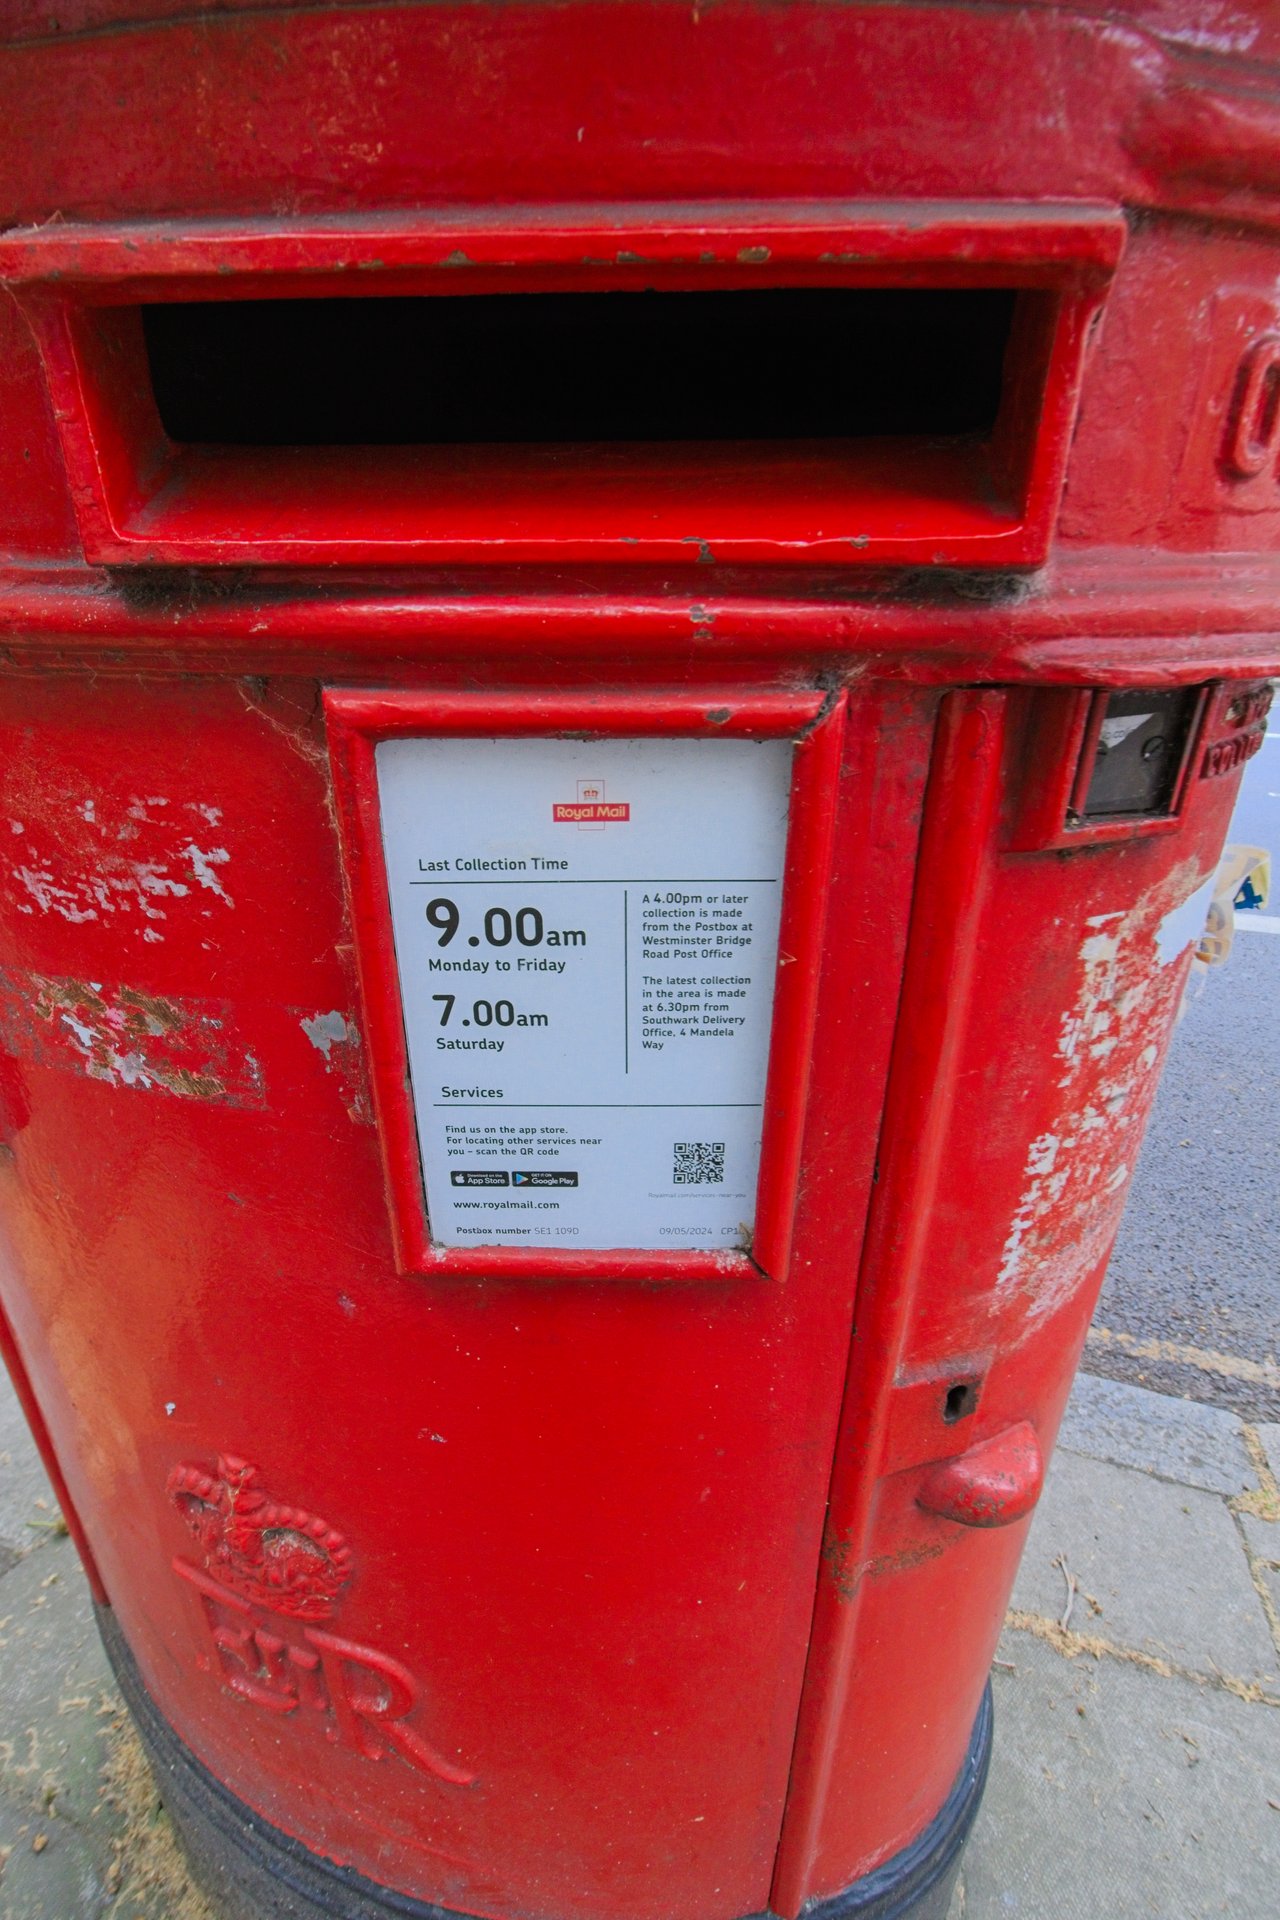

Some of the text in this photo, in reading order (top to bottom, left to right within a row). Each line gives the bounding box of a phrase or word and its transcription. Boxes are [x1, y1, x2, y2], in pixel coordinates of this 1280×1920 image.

[556, 805, 626, 821] Royal Mail
[418, 857, 569, 872] Last Collection Time
[641, 892, 750, 906] A 4.00pm or later
[642, 907, 743, 918] collection is made
[425, 897, 587, 948] 9.00am
[642, 921, 754, 932] from the Postbox at
[641, 935, 753, 947] Westminster Bridge
[642, 948, 734, 959] Road Post Office
[428, 957, 566, 974] Monday to Friday
[642, 975, 752, 986] The latest collection
[642, 988, 747, 999] in the area is made
[431, 994, 549, 1027] 7.00am
[641, 1001, 730, 1014] at 6.30pm from
[642, 1015, 746, 1026] Southwark Delivery
[679, 1027, 687, 1037] 4
[689, 1027, 735, 1037] Mandela
[436, 1037, 505, 1053] Saturday
[641, 1040, 665, 1051] Way
[441, 1085, 504, 1099] Services
[445, 1125, 467, 1134] Find
[499, 1125, 516, 1134] the
[518, 1127, 538, 1136] app
[539, 1126, 569, 1134] store.
[446, 1136, 463, 1145] For
[465, 1136, 504, 1147] locating
[507, 1136, 534, 1145] other
[536, 1136, 577, 1145] services
[447, 1148, 465, 1157] you
[475, 1148, 498, 1156] scan
[499, 1146, 517, 1156] the
[519, 1147, 534, 1157] QR
[536, 1147, 560, 1156] code
[467, 1177, 483, 1185] App
[531, 1177, 575, 1186] Google Play
[452, 1200, 560, 1211] www.royalmail.com
[455, 1226, 493, 1235] Postbox
[495, 1227, 532, 1235] number
[534, 1227, 552, 1235] SE1
[659, 1227, 713, 1236] 09/05/2024
